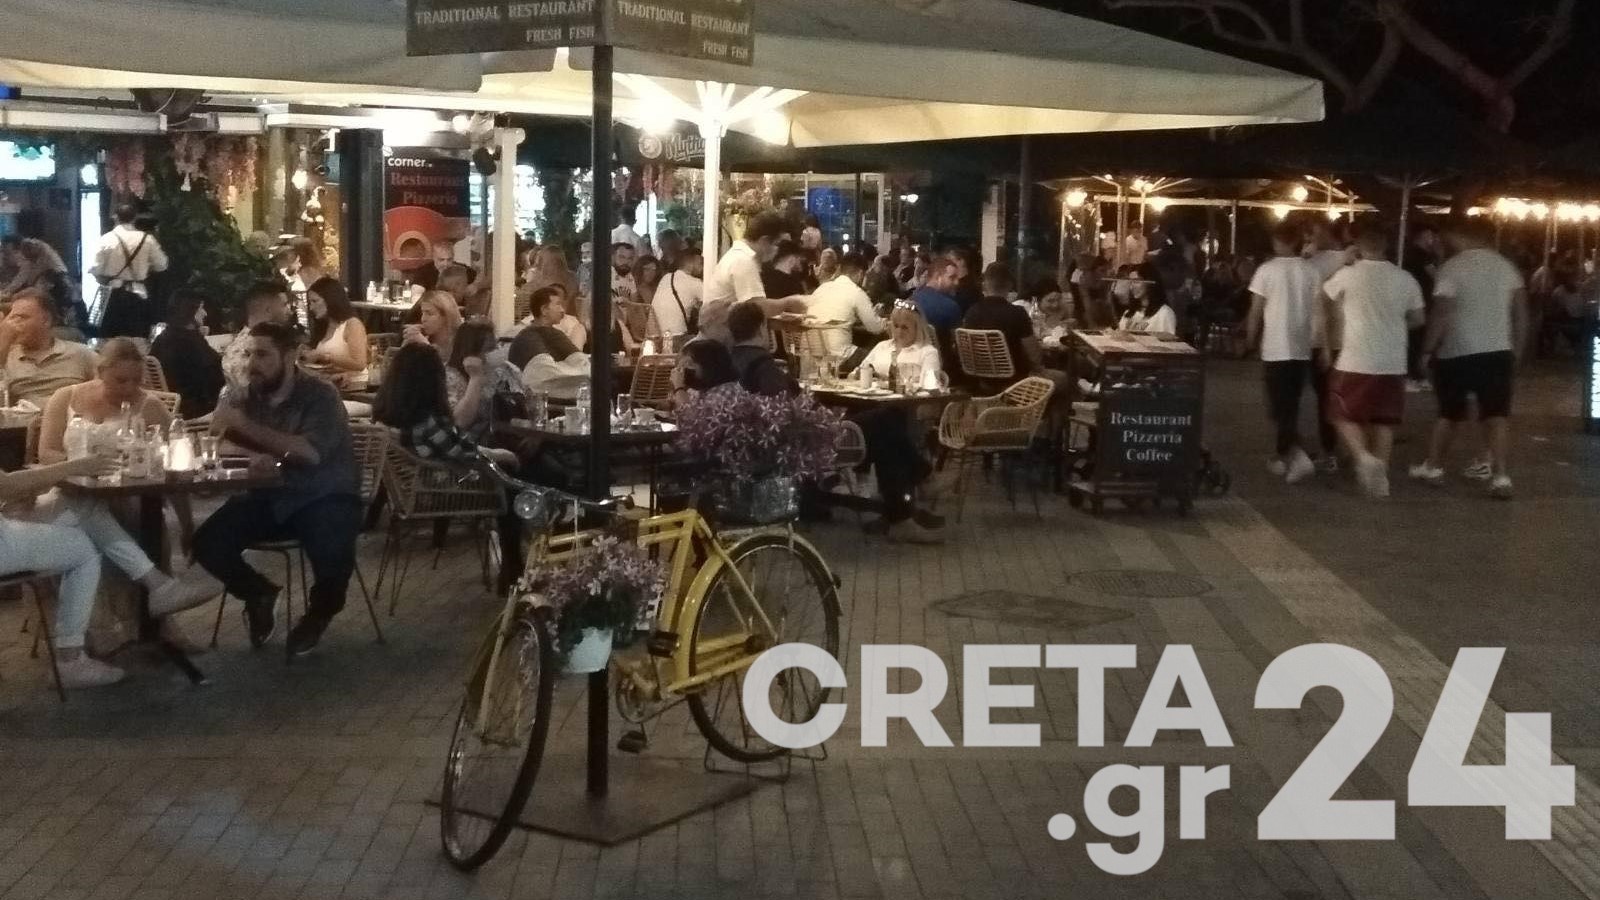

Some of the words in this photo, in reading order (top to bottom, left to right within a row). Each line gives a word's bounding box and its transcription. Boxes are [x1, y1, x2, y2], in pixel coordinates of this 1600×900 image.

[415, 6, 499, 25] TRADITIONAL
[508, 1, 593, 18] RESTAURANT
[617, 1, 686, 25] TRADITIONAL
[691, 13, 749, 35] RESTAURANT
[526, 28, 562, 42] FRESH
[569, 26, 595, 40] FISH
[703, 41, 728, 57] FRESH
[732, 46, 748, 59] FISH
[1111, 412, 1192, 425] Restaurant
[1122, 430, 1182, 443] Pizzeria
[1126, 449, 1173, 461] Coffee
